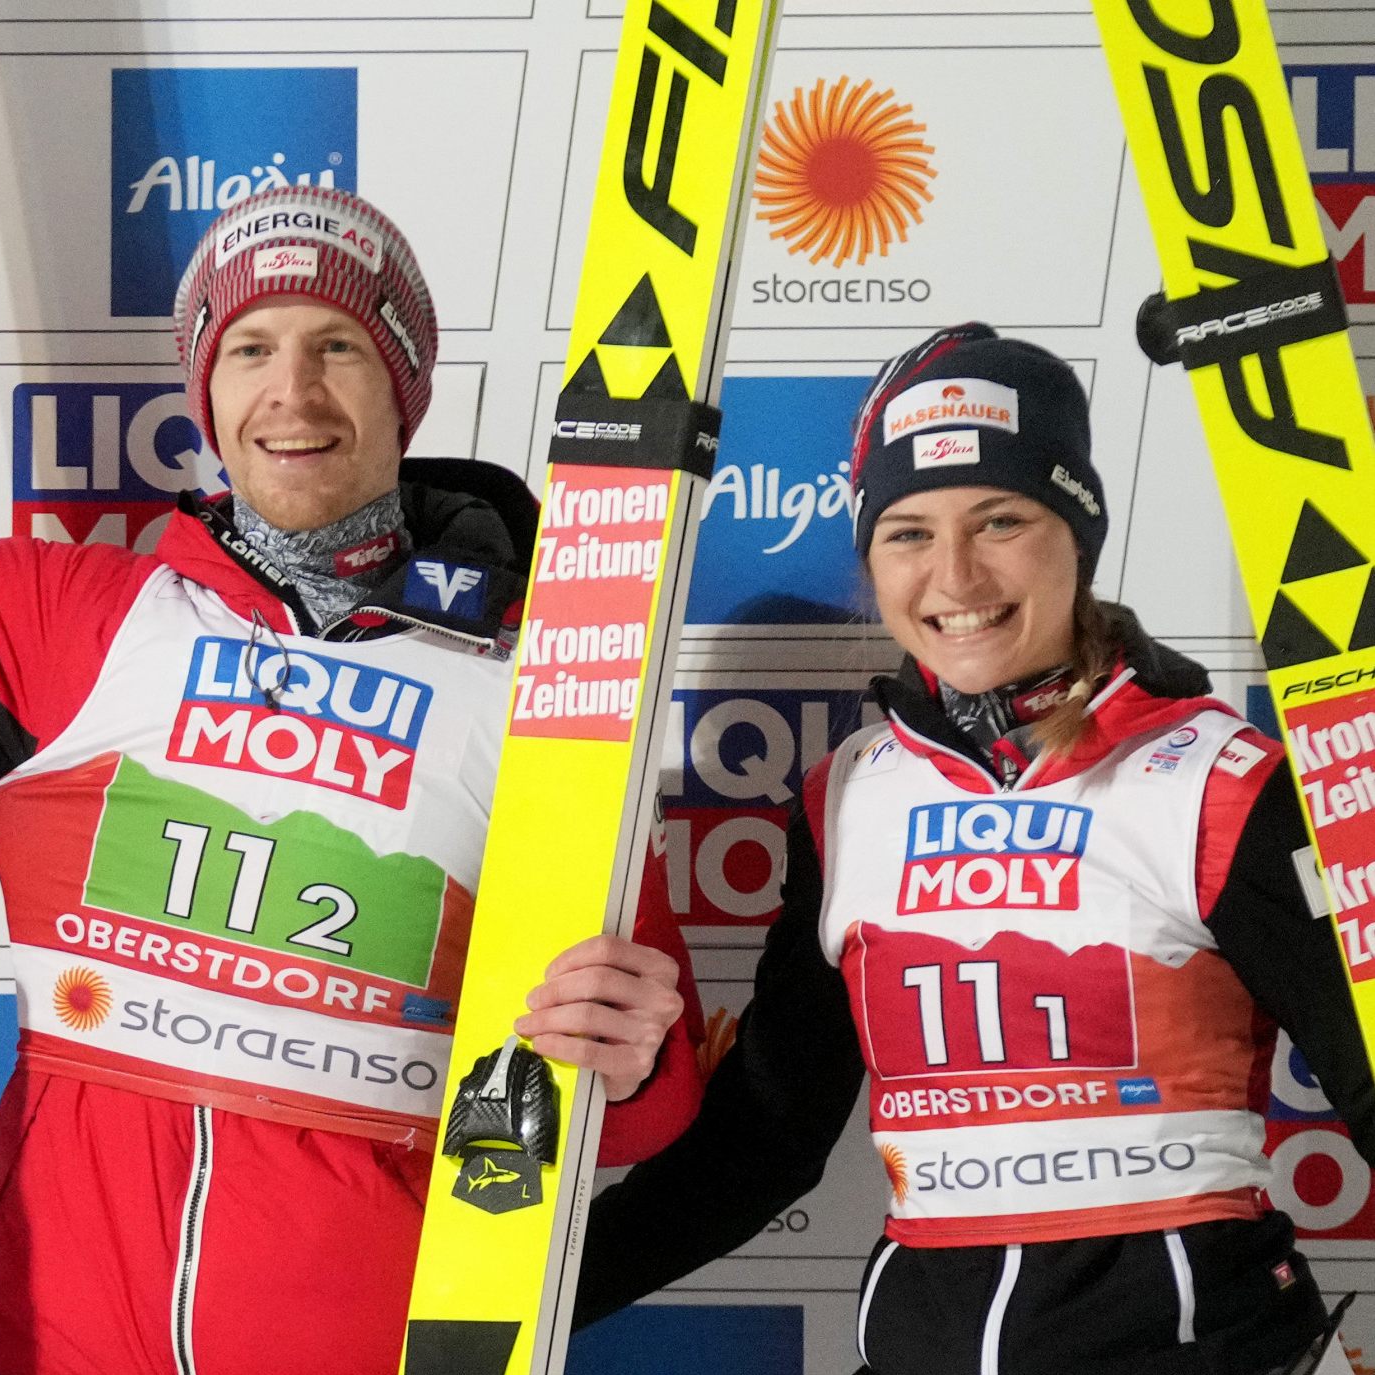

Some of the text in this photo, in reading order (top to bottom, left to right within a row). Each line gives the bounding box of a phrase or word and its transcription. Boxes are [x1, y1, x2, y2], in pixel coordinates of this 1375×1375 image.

[752, 273, 929, 303] storaenso
[1176, 291, 1323, 345] RACECODE
[31, 395, 228, 493] LIQ
[889, 404, 1011, 435] HASENAUER
[542, 481, 668, 528] Kronen
[700, 461, 854, 554] Allgä
[344, 537, 394, 568] Tirol
[536, 532, 663, 583] Zeitung
[520, 618, 645, 667] Kronen
[195, 642, 422, 740] LIQUI
[513, 670, 641, 720] Zeitung
[1282, 668, 1375, 700] FISCH
[177, 706, 411, 798] MOLY
[1289, 711, 1375, 777] Kron
[914, 802, 1086, 856] LIQUI
[162, 819, 359, 957] 11 2
[904, 857, 1076, 909] MOLY
[55, 912, 392, 1014] OBERSTDORF
[902, 960, 1070, 1067] 11 1
[119, 998, 439, 1091] storaenso
[879, 1080, 1107, 1119] OBERSTDORF
[916, 1142, 1197, 1191] storaenso
